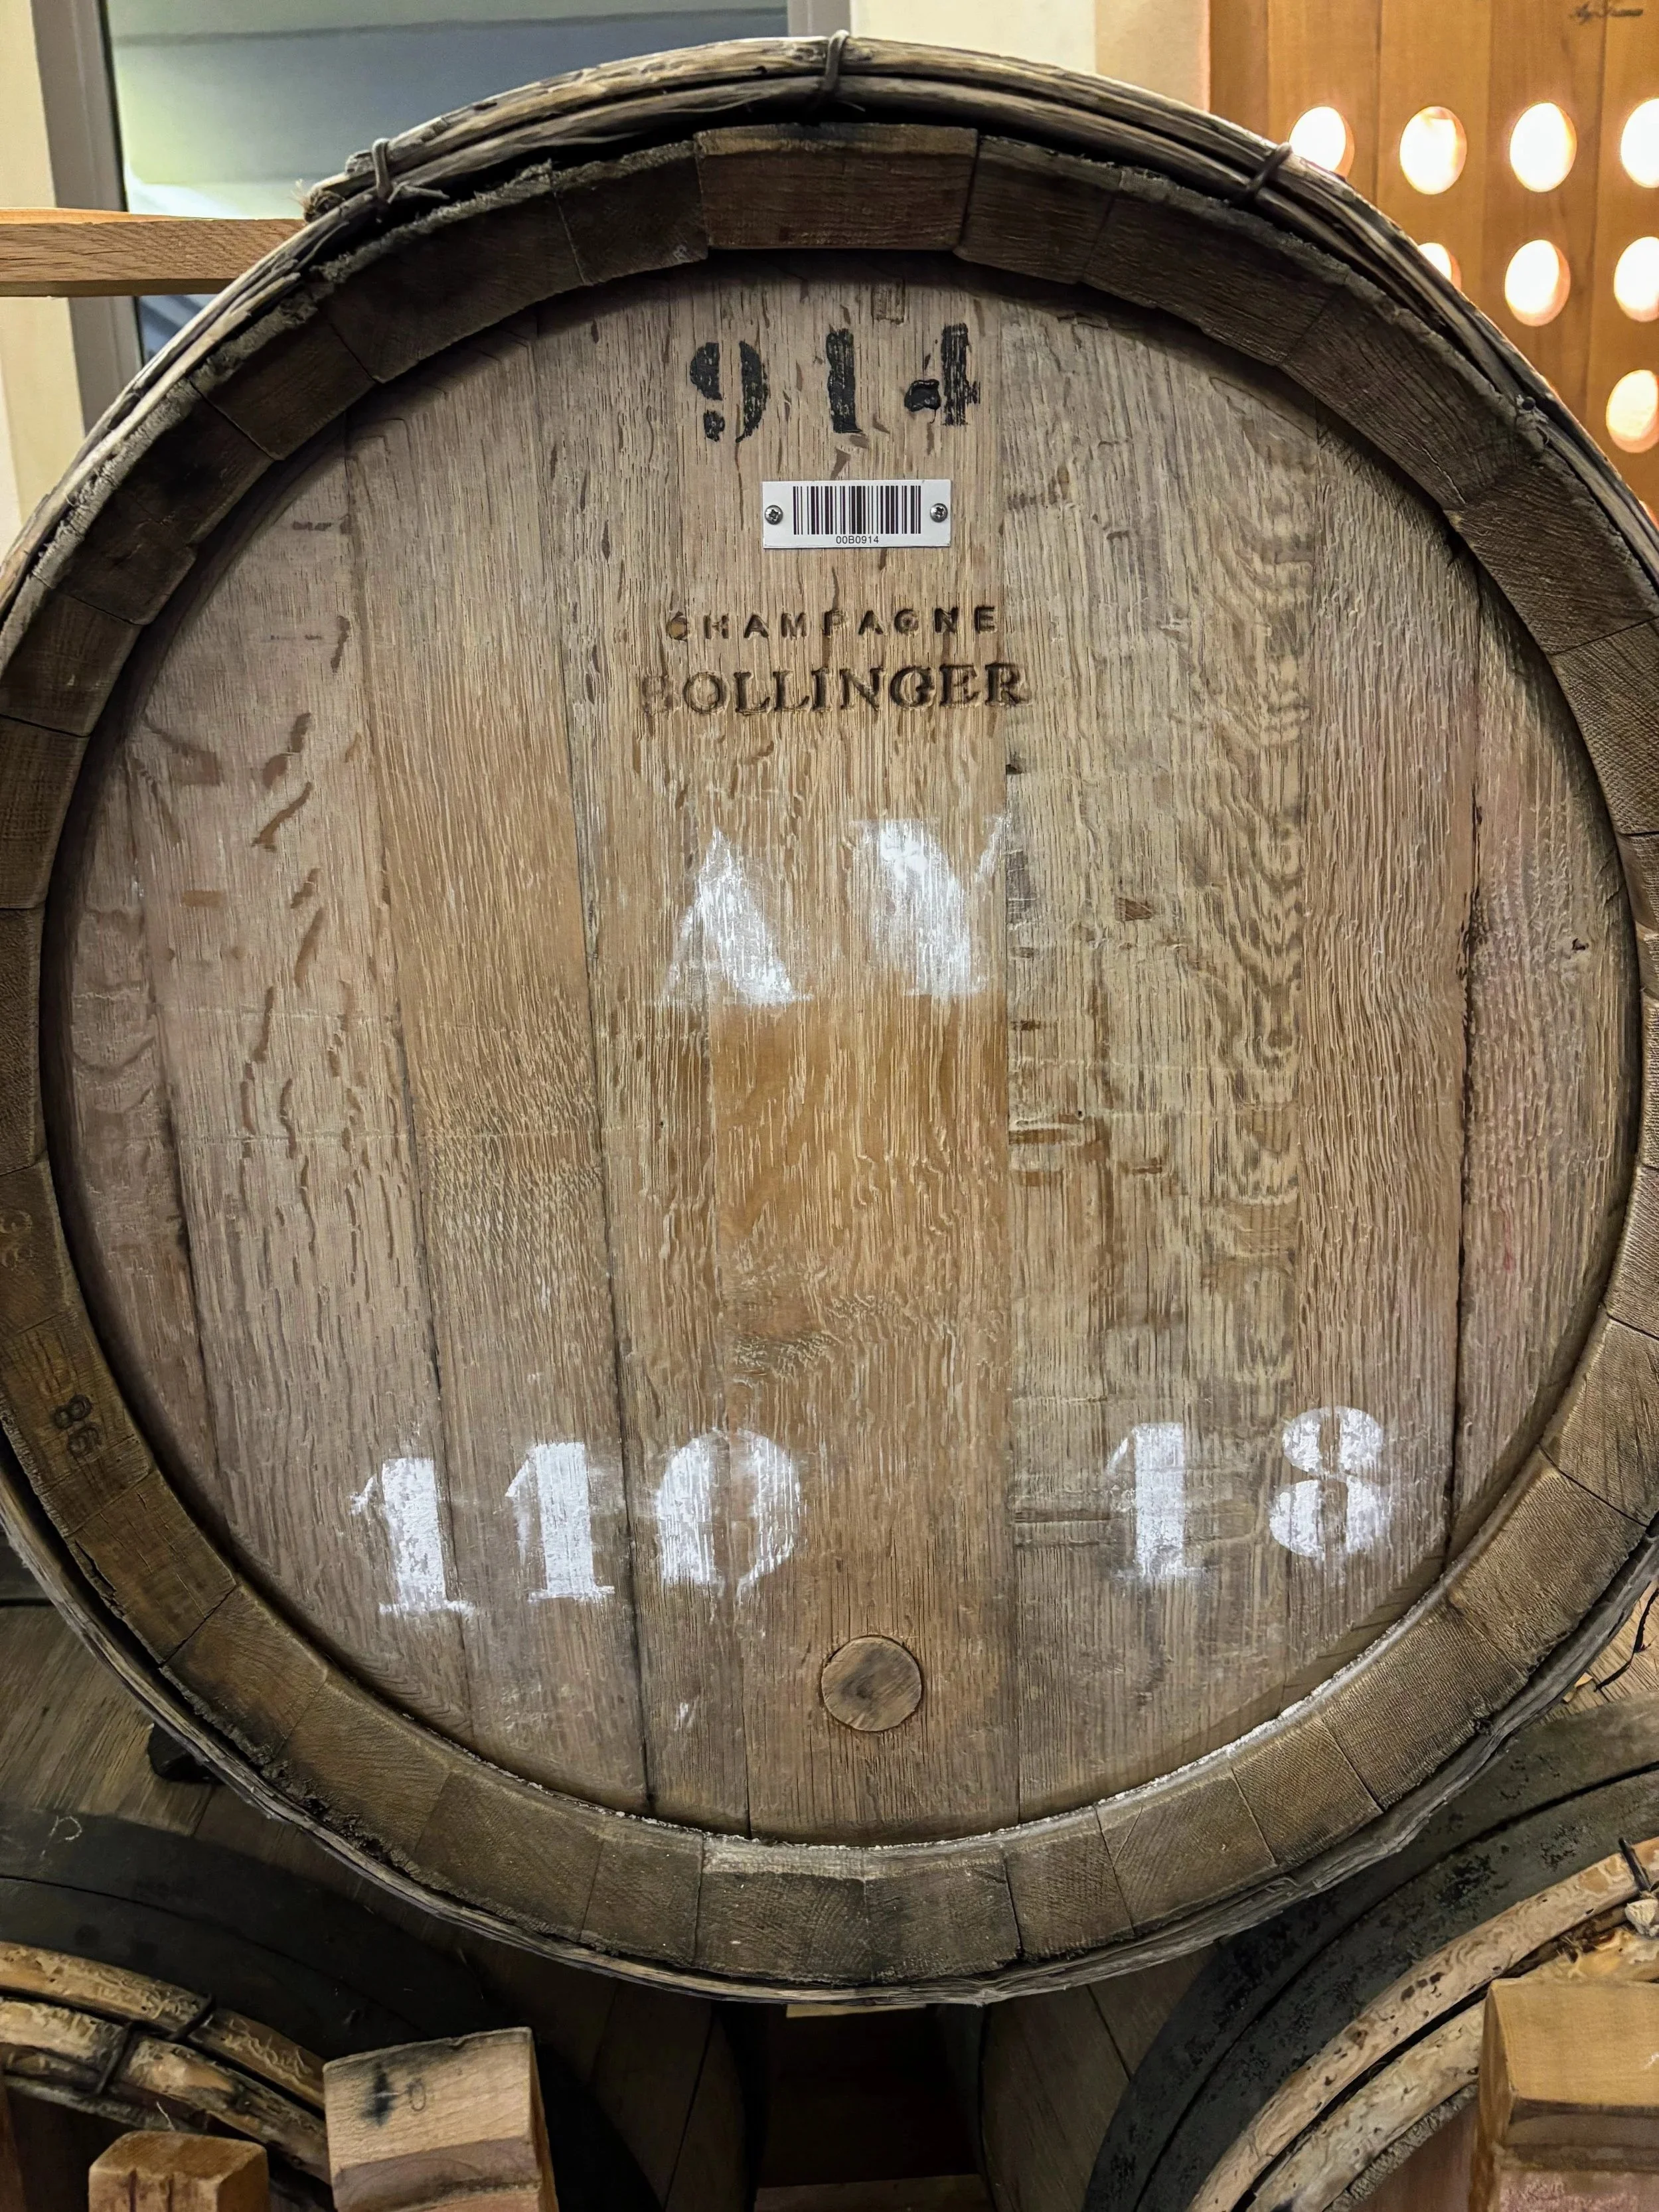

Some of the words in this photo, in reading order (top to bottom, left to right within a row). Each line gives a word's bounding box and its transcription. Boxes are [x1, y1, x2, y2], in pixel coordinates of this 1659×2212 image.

[689, 323, 981, 443] 914
[836, 534, 880, 544] 00B0914
[667, 605, 998, 642] CHAMPAGNE
[641, 661, 1034, 718] BOLLINGER
[1105, 1405, 1393, 1581] 18
